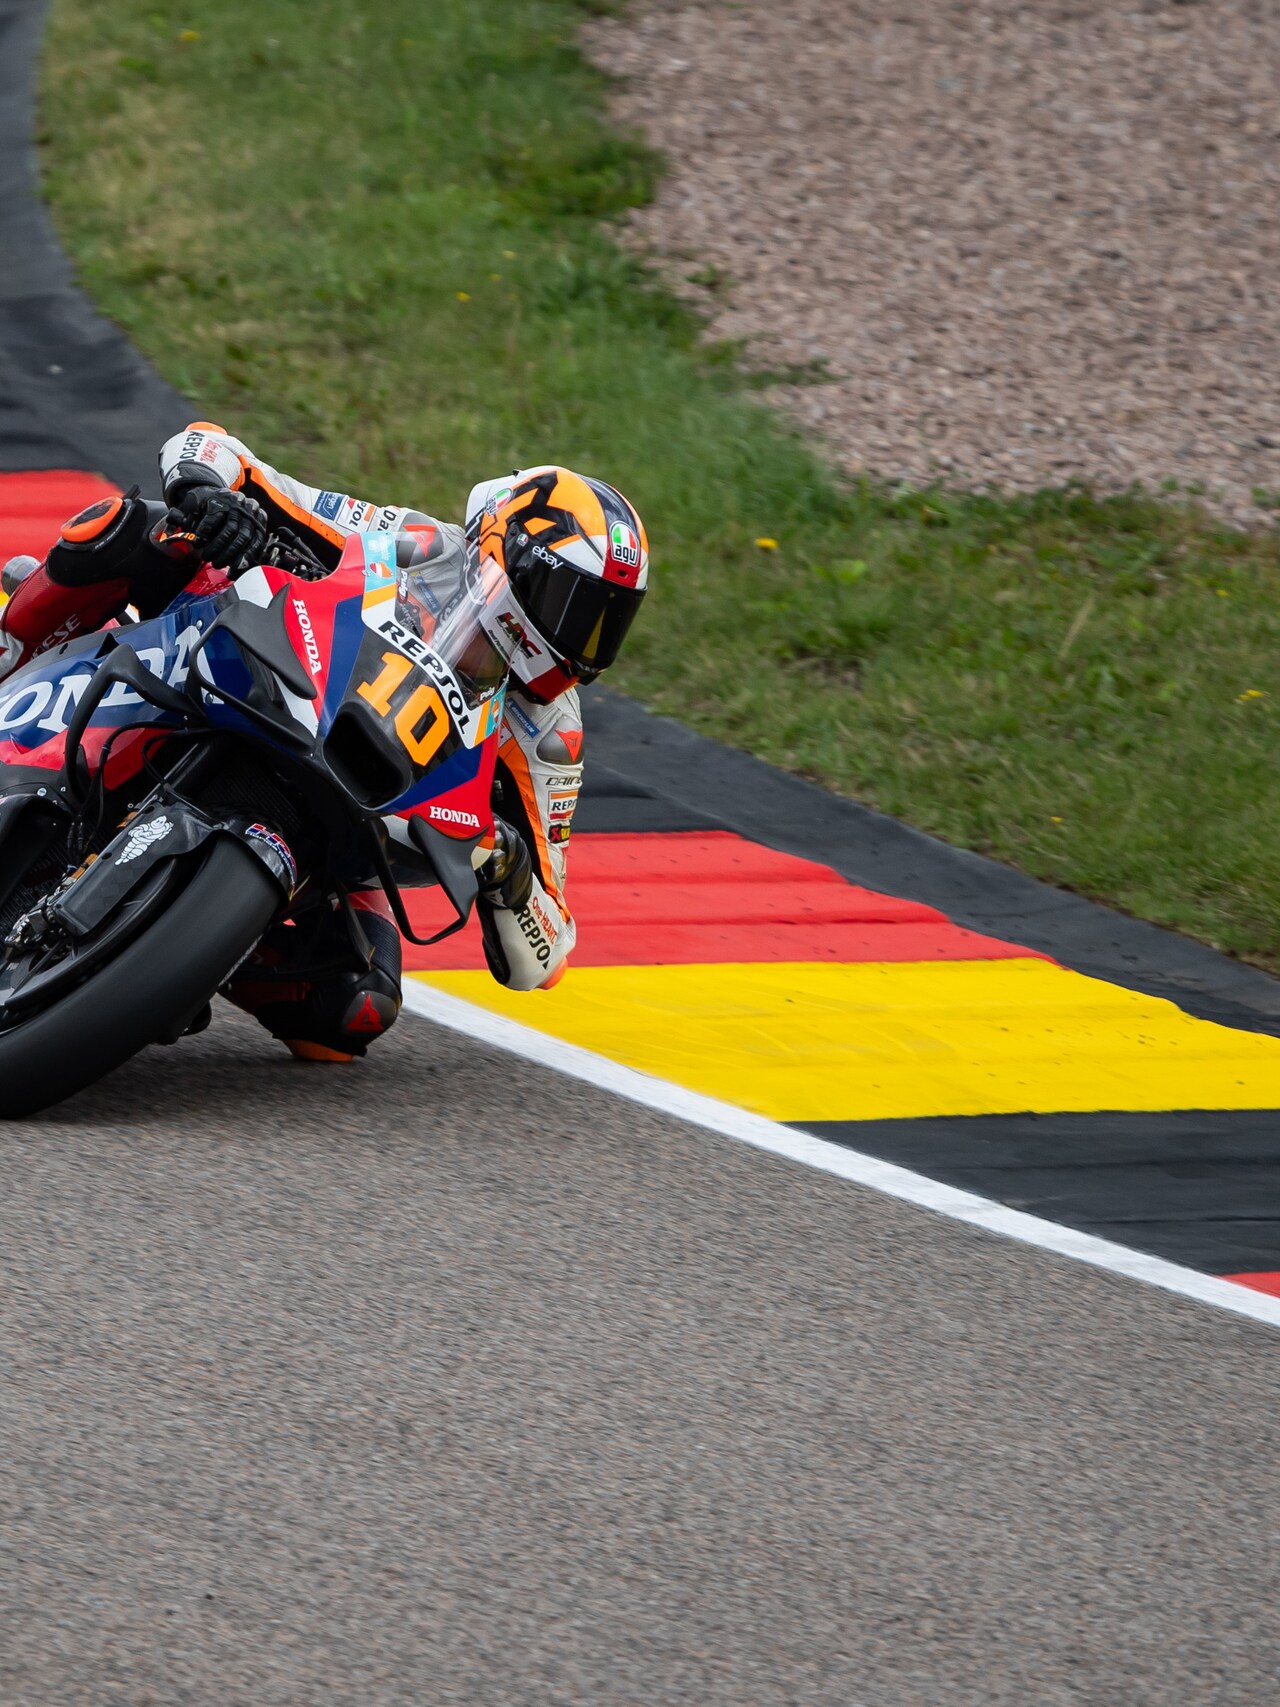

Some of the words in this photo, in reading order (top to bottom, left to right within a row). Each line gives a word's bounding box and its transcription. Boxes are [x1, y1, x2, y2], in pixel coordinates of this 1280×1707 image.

[532, 545, 564, 570] ebay
[614, 544, 637, 566] agv
[293, 598, 321, 675] HONDA
[378, 620, 471, 735] REPSOL
[356, 651, 450, 767] 10
[429, 805, 480, 828] HONDA
